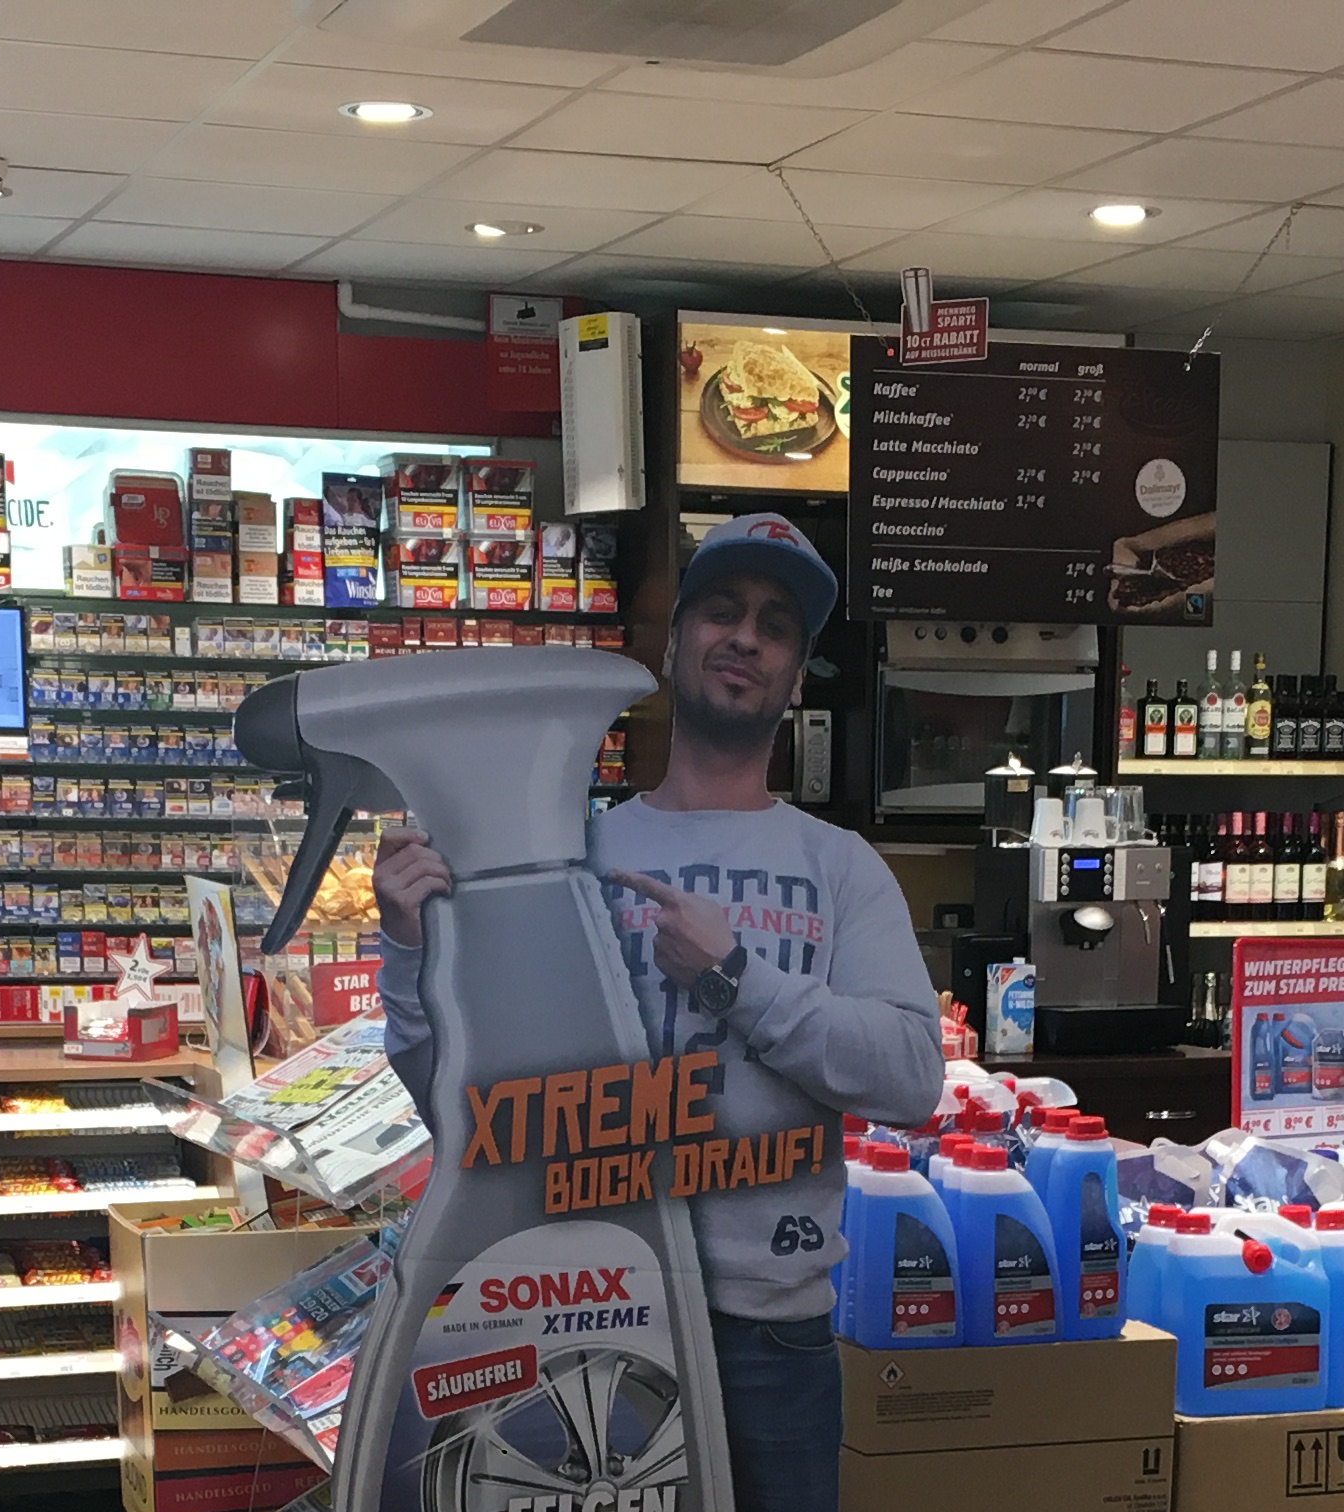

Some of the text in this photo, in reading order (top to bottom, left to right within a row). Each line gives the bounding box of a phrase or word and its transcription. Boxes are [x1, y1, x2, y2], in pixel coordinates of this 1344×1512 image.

[937, 315, 976, 328] SPART!
[906, 330, 980, 348] 10 RABATT
[1019, 361, 1103, 377] normal groß
[873, 439, 907, 452] Latte
[1140, 484, 1181, 495] Dallmayr
[872, 558, 988, 573] Heiße Schokolade
[872, 586, 893, 599] Tee
[129, 959, 139, 972] 2
[334, 974, 369, 992] STAR
[1243, 980, 1275, 997] ZUM
[1278, 977, 1315, 994] STAR
[314, 1085, 381, 1129] Neue
[461, 1052, 718, 1170] XTREME
[545, 1125, 825, 1214] BOCK DRAUF!
[770, 1215, 825, 1256] 69
[898, 1258, 918, 1268] star
[998, 1258, 1017, 1268] star
[480, 1267, 631, 1314] SONAX
[443, 1317, 523, 1334] MADE IN GERMANY
[542, 1306, 650, 1335] XTREME
[1213, 1312, 1240, 1323] star
[427, 1359, 522, 1402] SÄUREFREI
[174, 1442, 277, 1455] HANDELSGOLD
[176, 1482, 272, 1502] HANDELSGOLD
